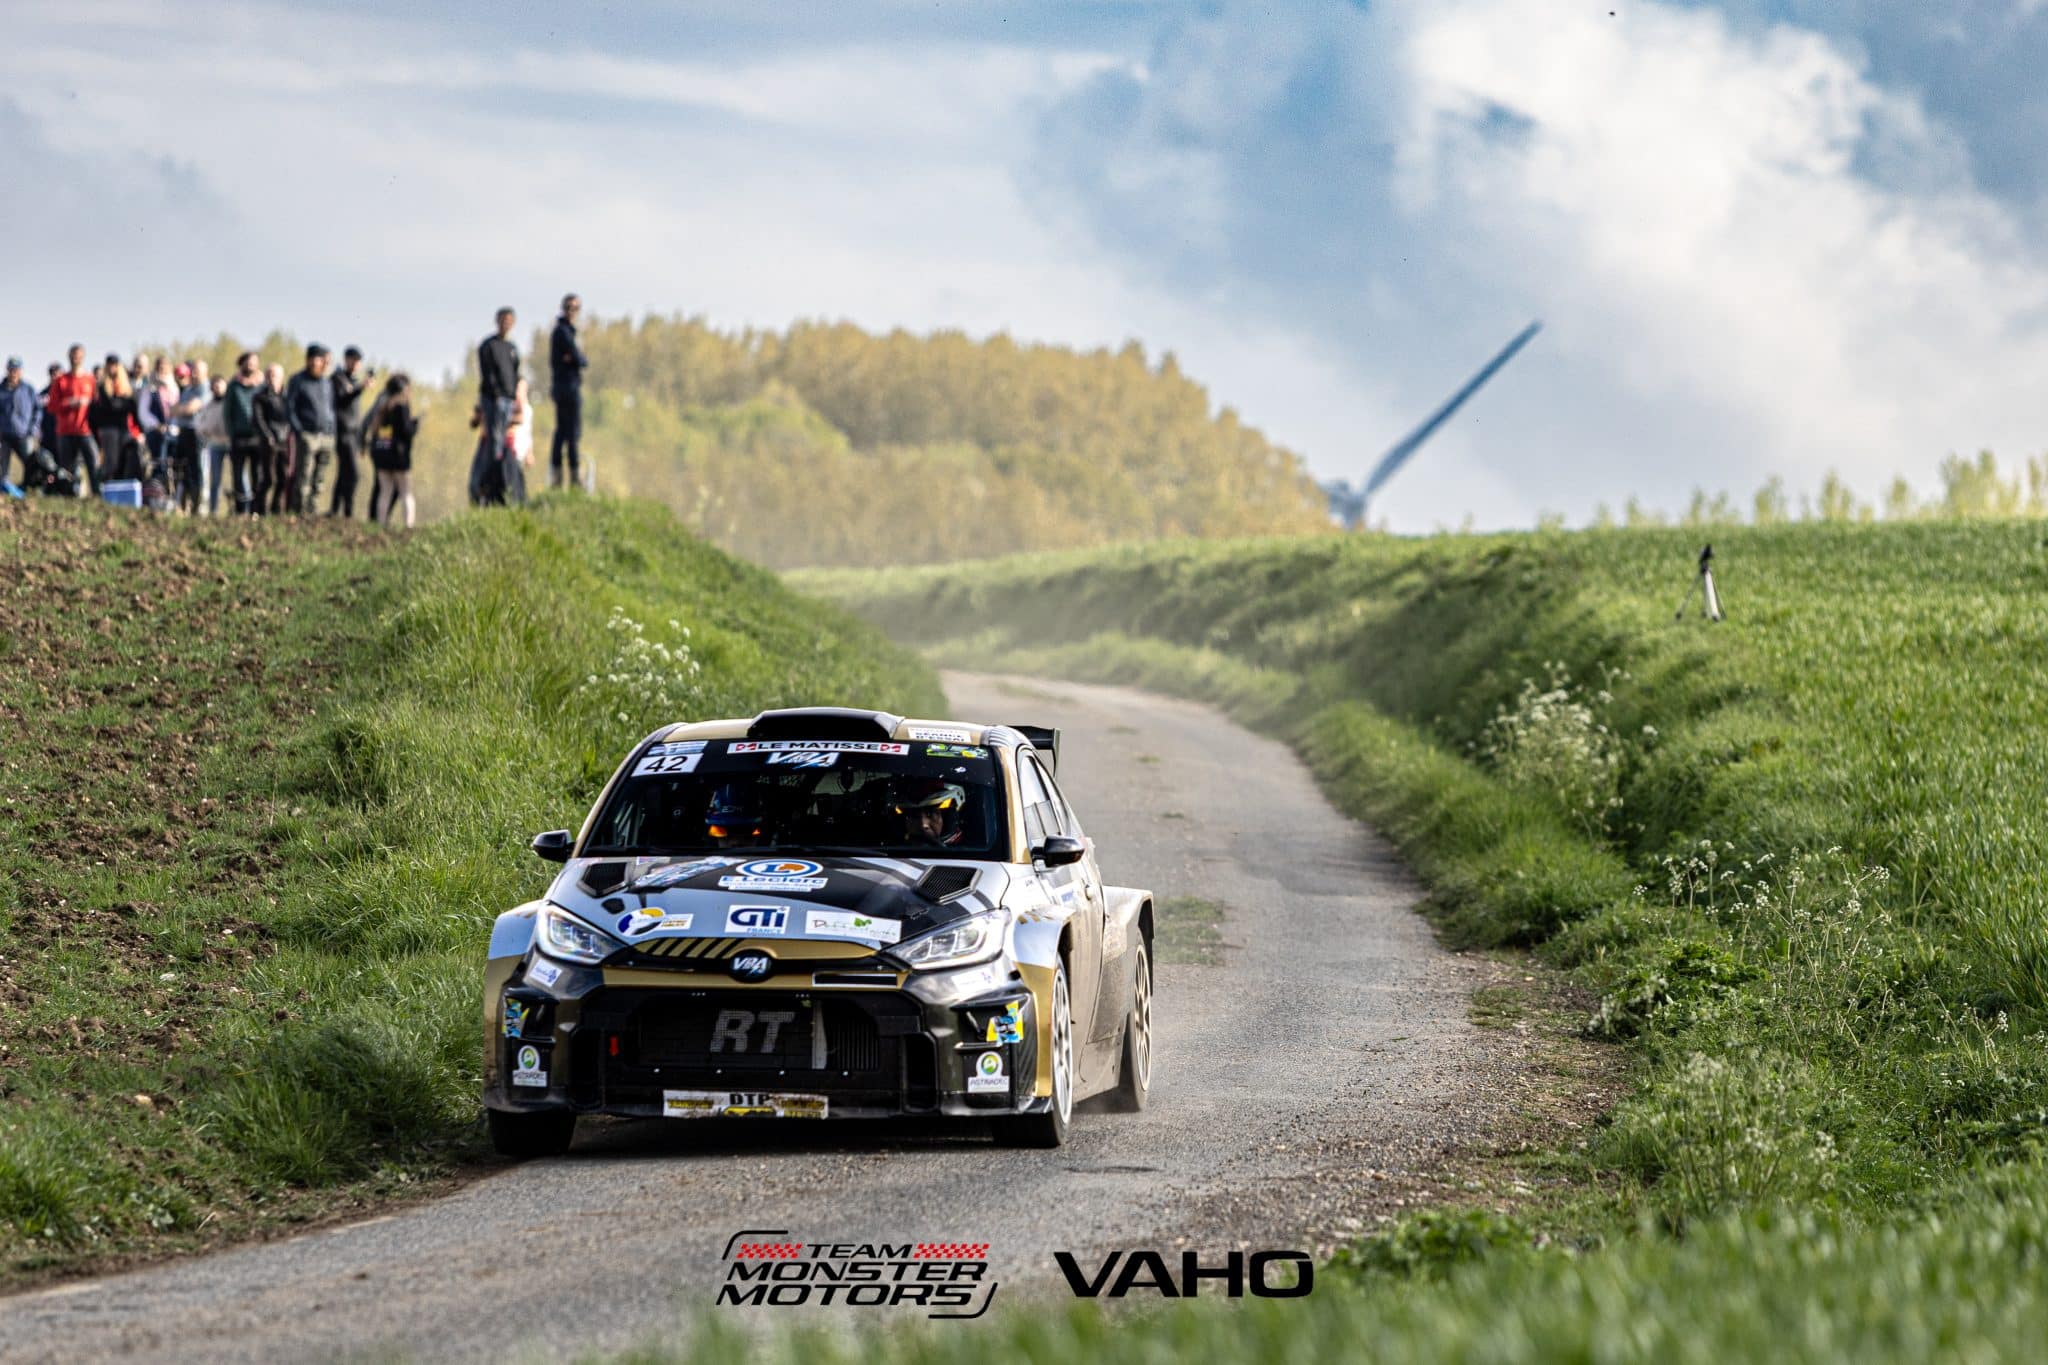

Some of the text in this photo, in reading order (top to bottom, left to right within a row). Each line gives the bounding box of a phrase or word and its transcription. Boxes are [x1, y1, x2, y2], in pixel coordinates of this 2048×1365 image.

[788, 742, 879, 751] MATISSE
[644, 756, 688, 772] 42
[710, 1010, 796, 1053] RT
